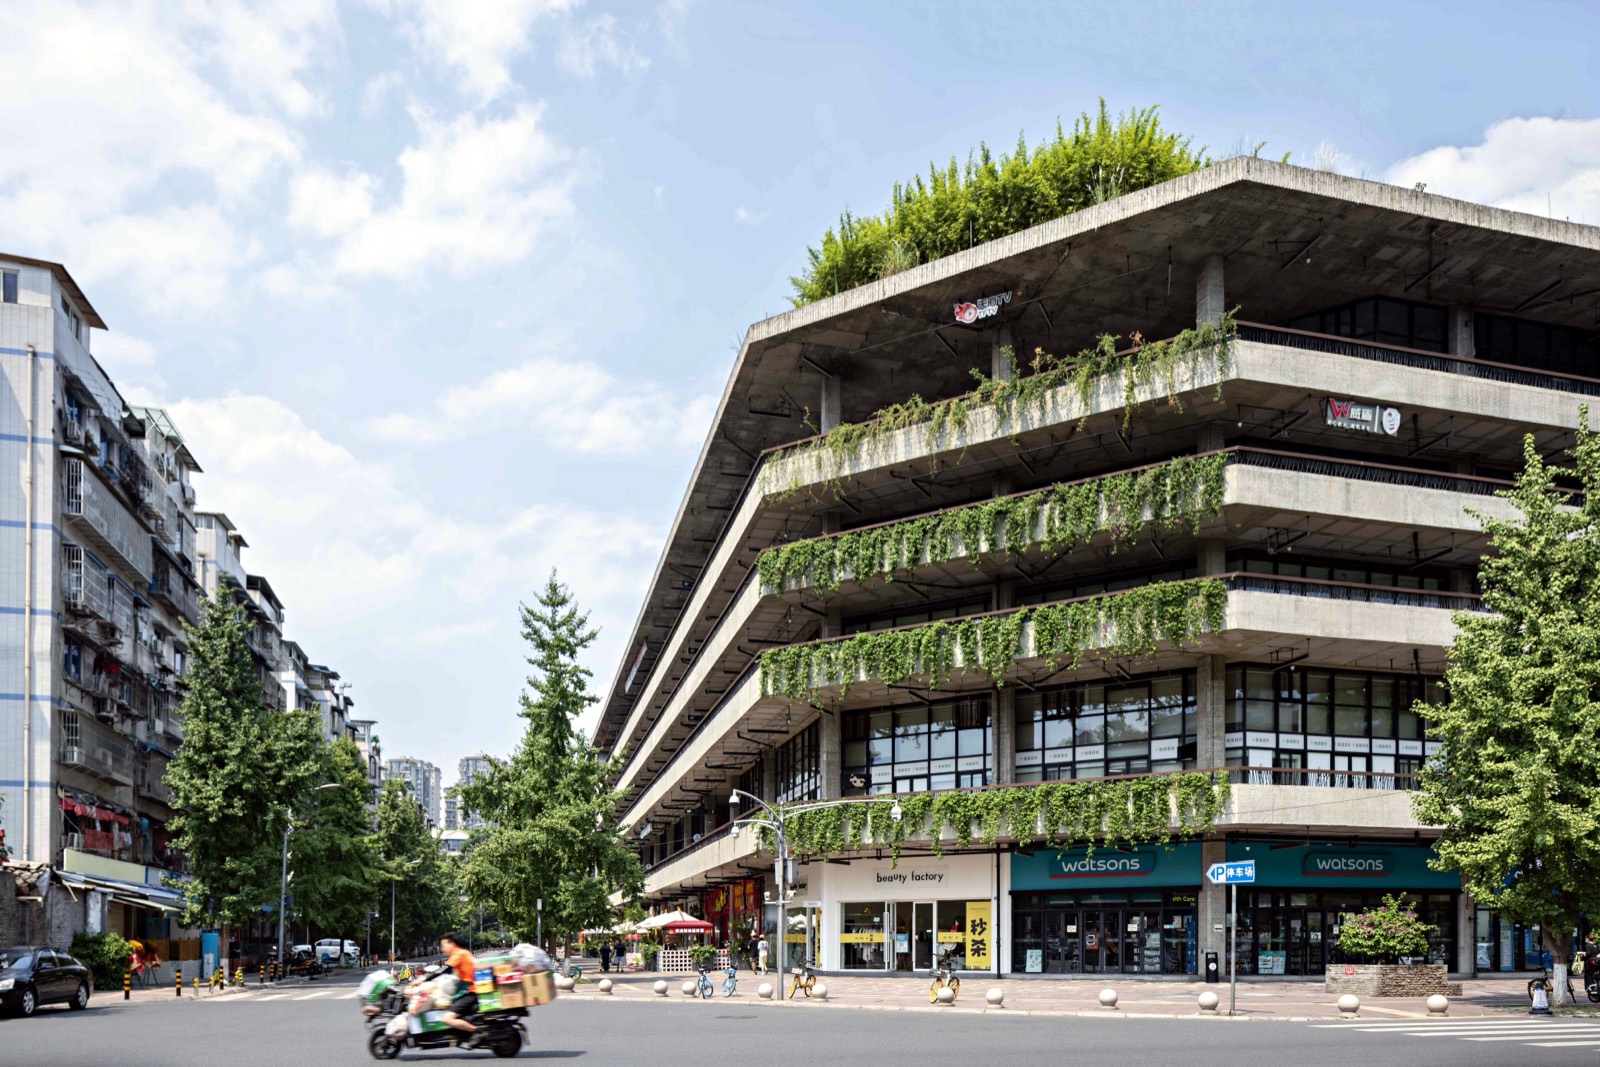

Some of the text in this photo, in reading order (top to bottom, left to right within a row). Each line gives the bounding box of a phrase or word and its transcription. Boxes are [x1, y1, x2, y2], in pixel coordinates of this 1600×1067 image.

[1061, 858, 1140, 872] watsons
[1316, 857, 1384, 871] watsons
[876, 870, 944, 884] beauty factory
[1216, 866, 1253, 881] P 停车场
[970, 917, 987, 957] 秒杀
